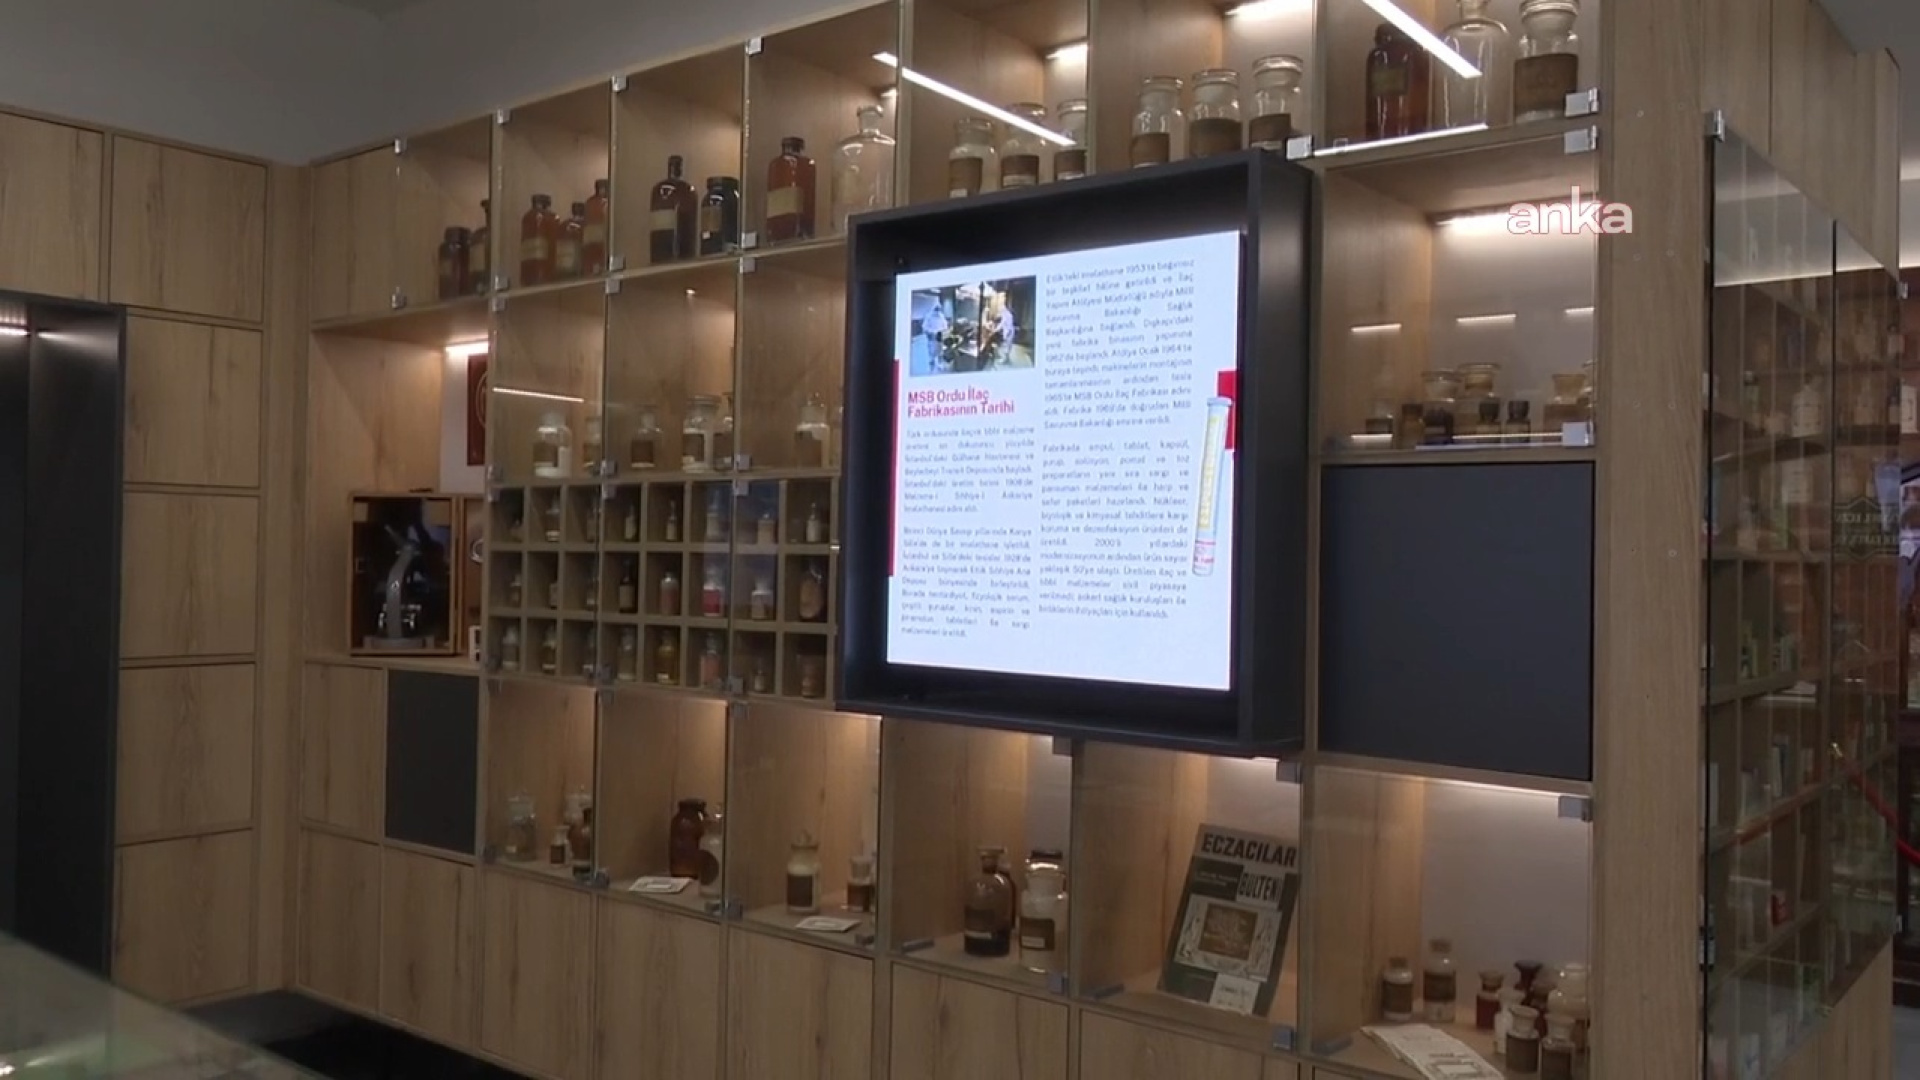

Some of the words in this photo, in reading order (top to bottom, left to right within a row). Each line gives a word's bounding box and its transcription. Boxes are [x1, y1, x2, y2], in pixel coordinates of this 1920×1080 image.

[907, 390, 935, 404] MSB
[936, 388, 966, 402] Ordu
[967, 386, 989, 401] İlaç
[907, 404, 978, 417] Fabrikasının
[980, 400, 1015, 414] Tarihi
[1203, 832, 1297, 868] ECZACILAR
